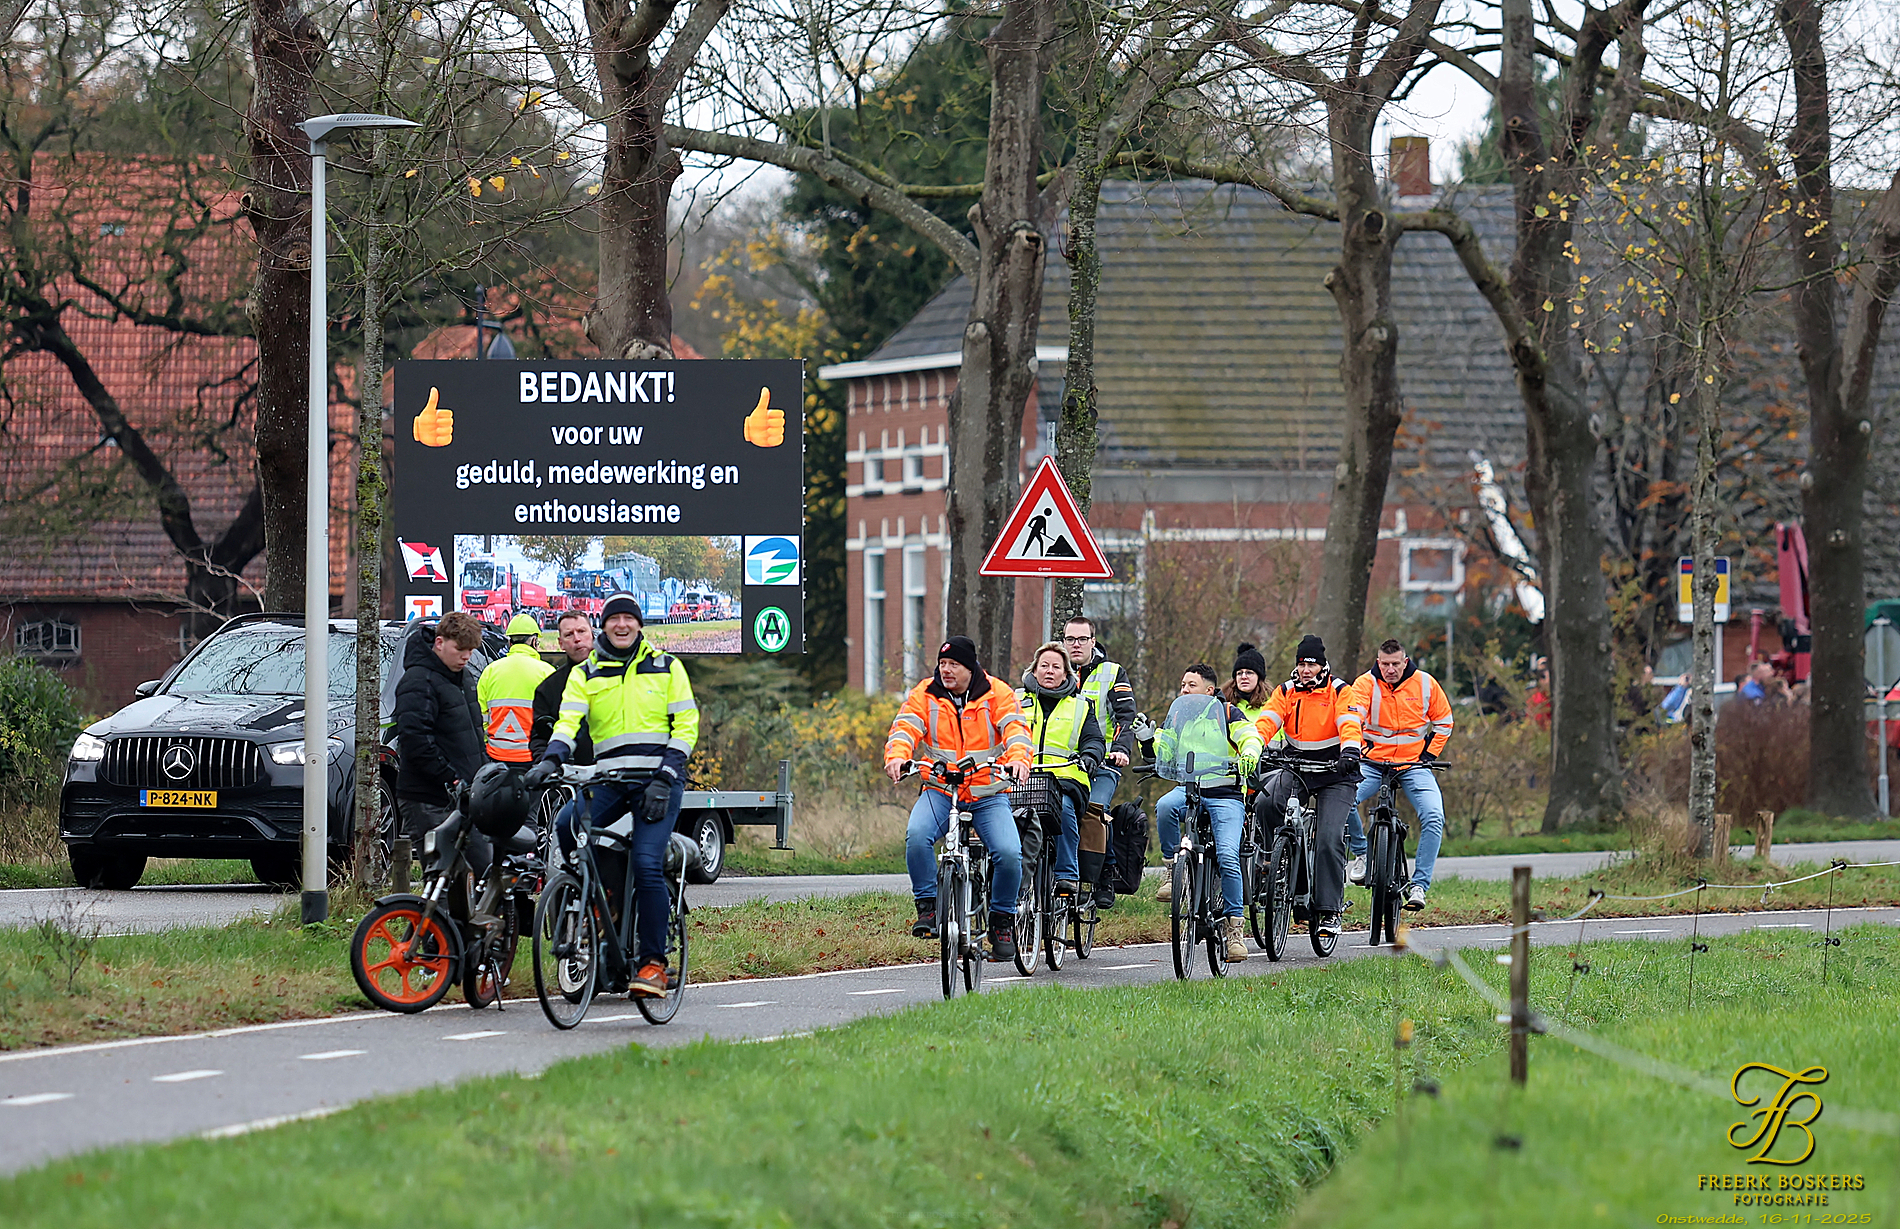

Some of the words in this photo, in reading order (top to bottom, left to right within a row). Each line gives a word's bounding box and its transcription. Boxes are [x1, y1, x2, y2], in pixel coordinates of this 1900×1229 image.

[519, 371, 675, 403] BEDANKT!
[551, 426, 603, 445] voor
[608, 426, 643, 445] uw
[456, 460, 542, 489] geduld,
[548, 460, 705, 489] medewerking
[711, 465, 739, 484] en
[514, 499, 681, 523] enthousiasme
[150, 792, 213, 806] P-824-NK
